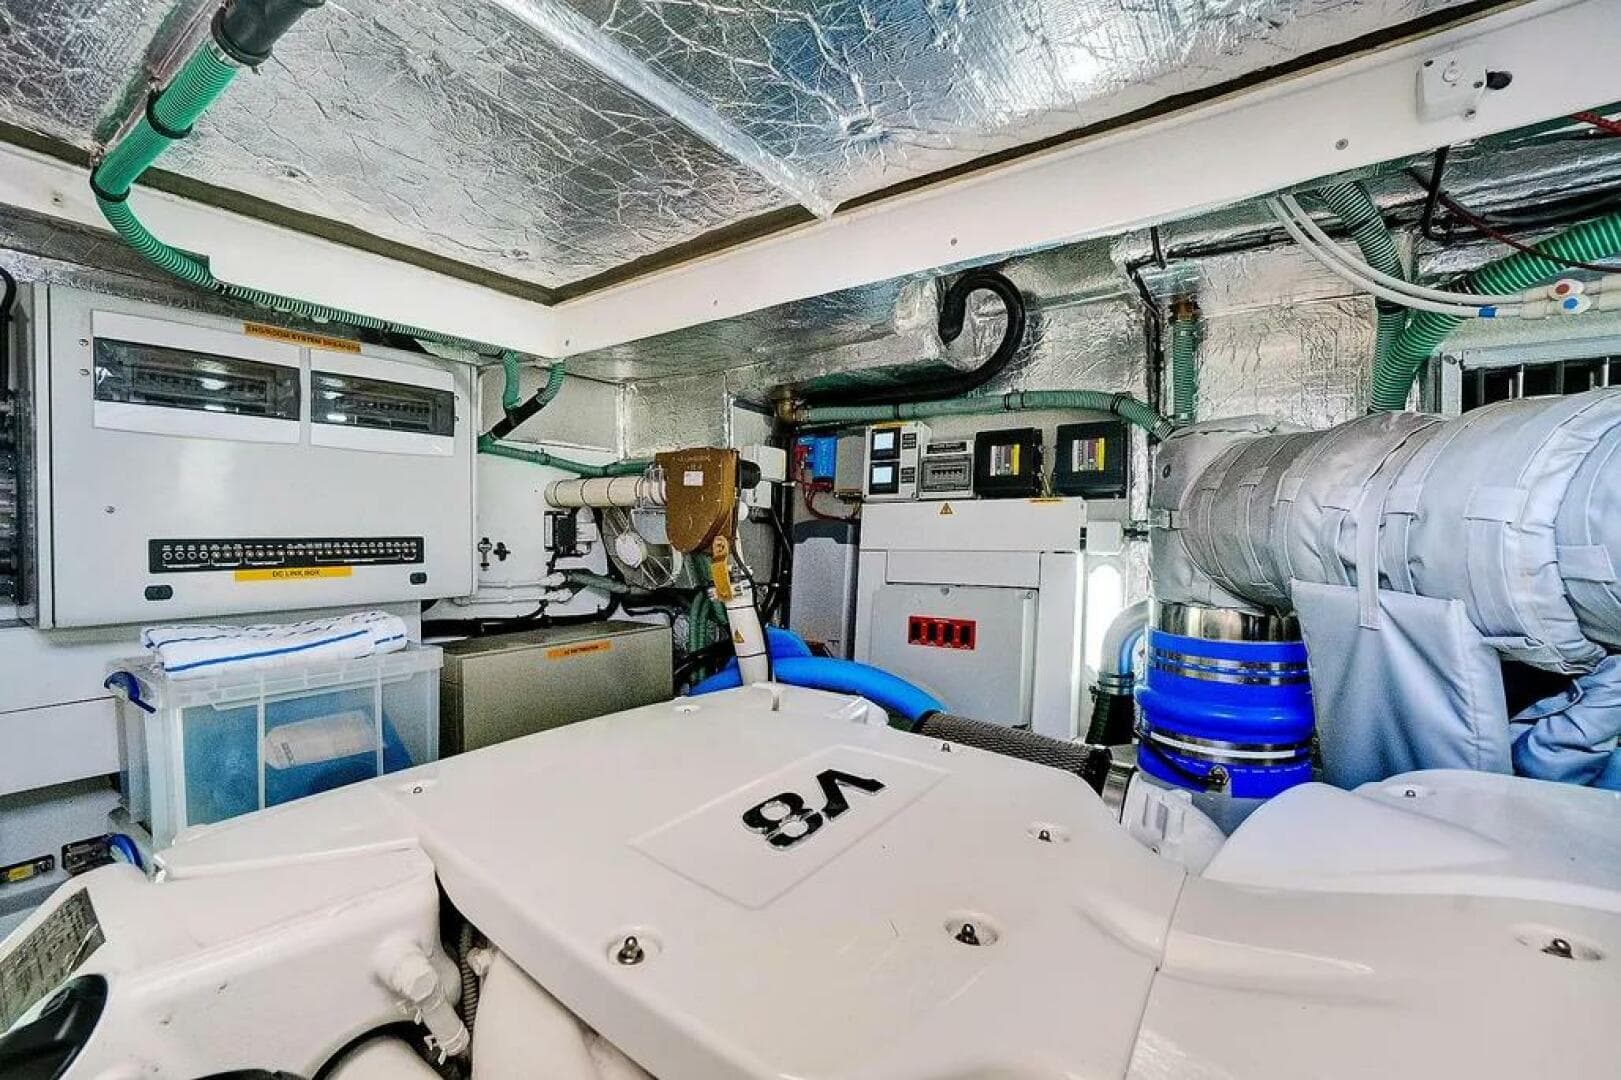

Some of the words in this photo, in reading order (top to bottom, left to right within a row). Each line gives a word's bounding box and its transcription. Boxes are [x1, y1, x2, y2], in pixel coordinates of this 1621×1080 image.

[292, 333, 321, 345] SYSTEM
[284, 569, 304, 577] LINK
[742, 769, 886, 850] V8
